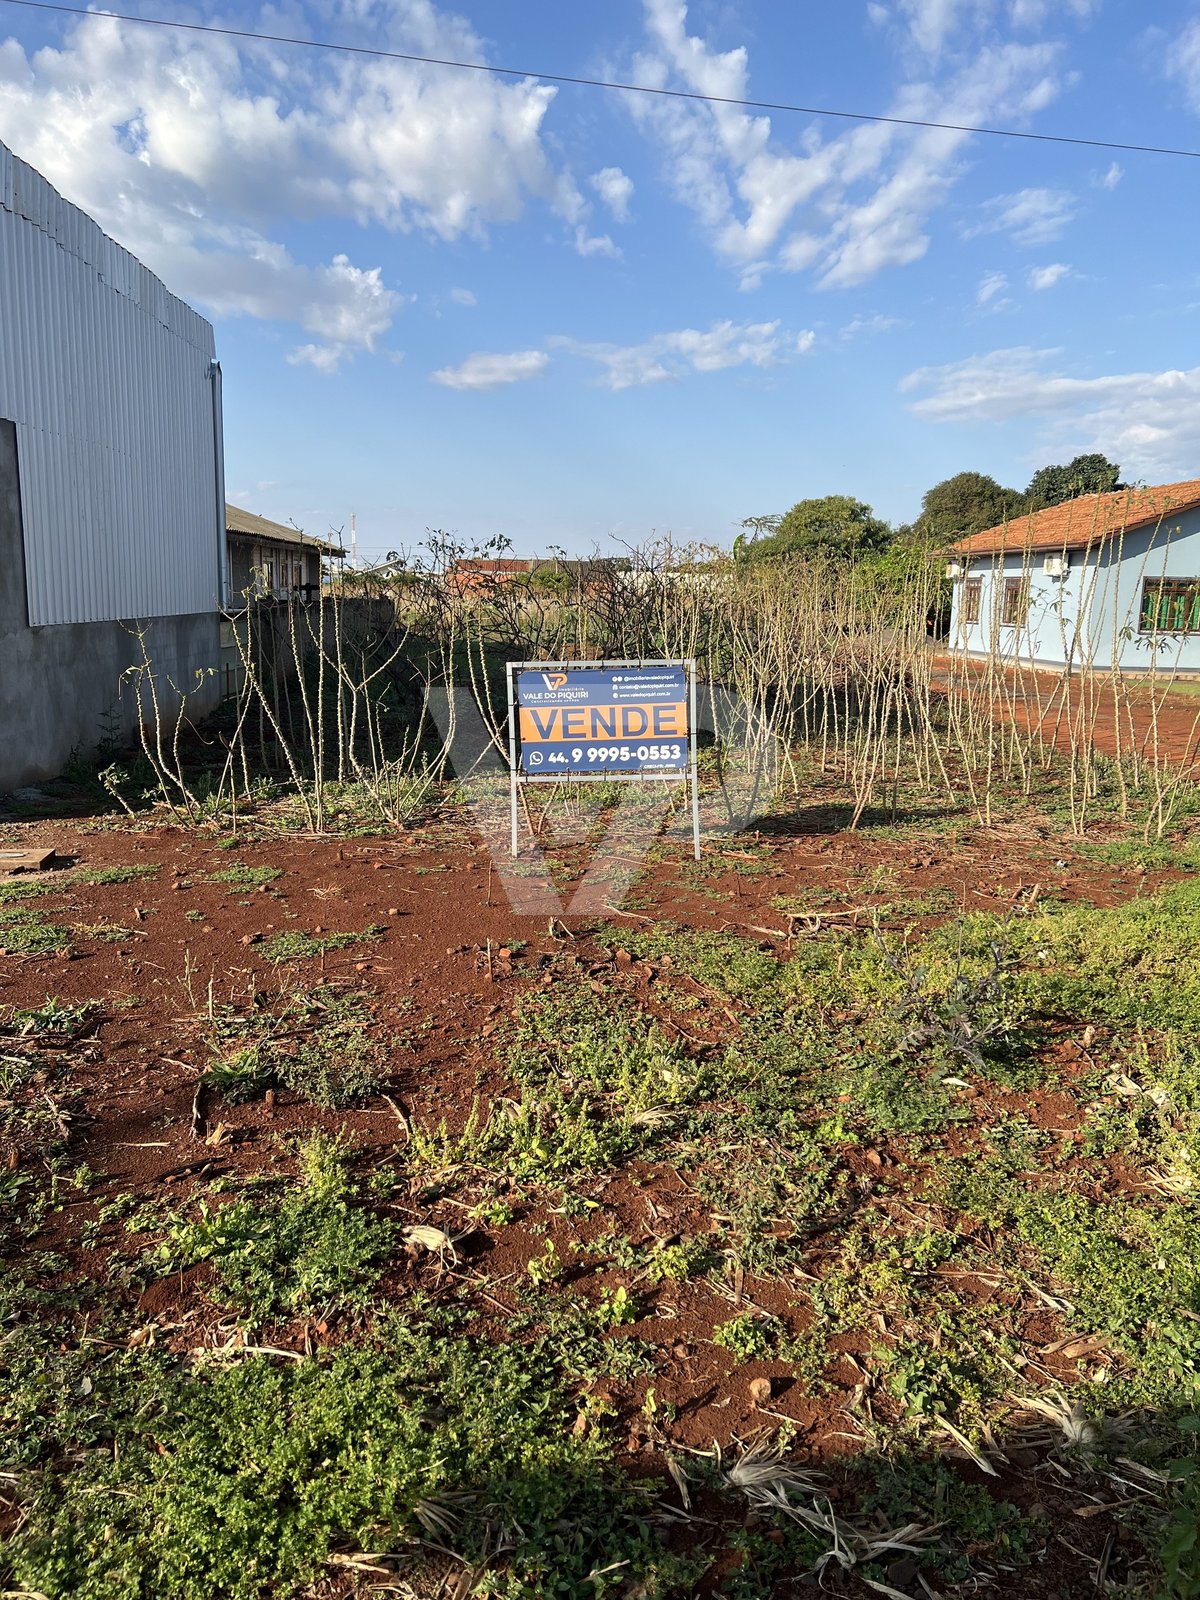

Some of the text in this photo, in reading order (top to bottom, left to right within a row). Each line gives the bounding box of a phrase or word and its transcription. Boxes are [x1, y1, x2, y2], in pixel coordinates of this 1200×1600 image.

[558, 691, 589, 700] PIQUIRI
[530, 705, 678, 739] VENDE
[547, 745, 682, 763] 44. 9 9995-0553
